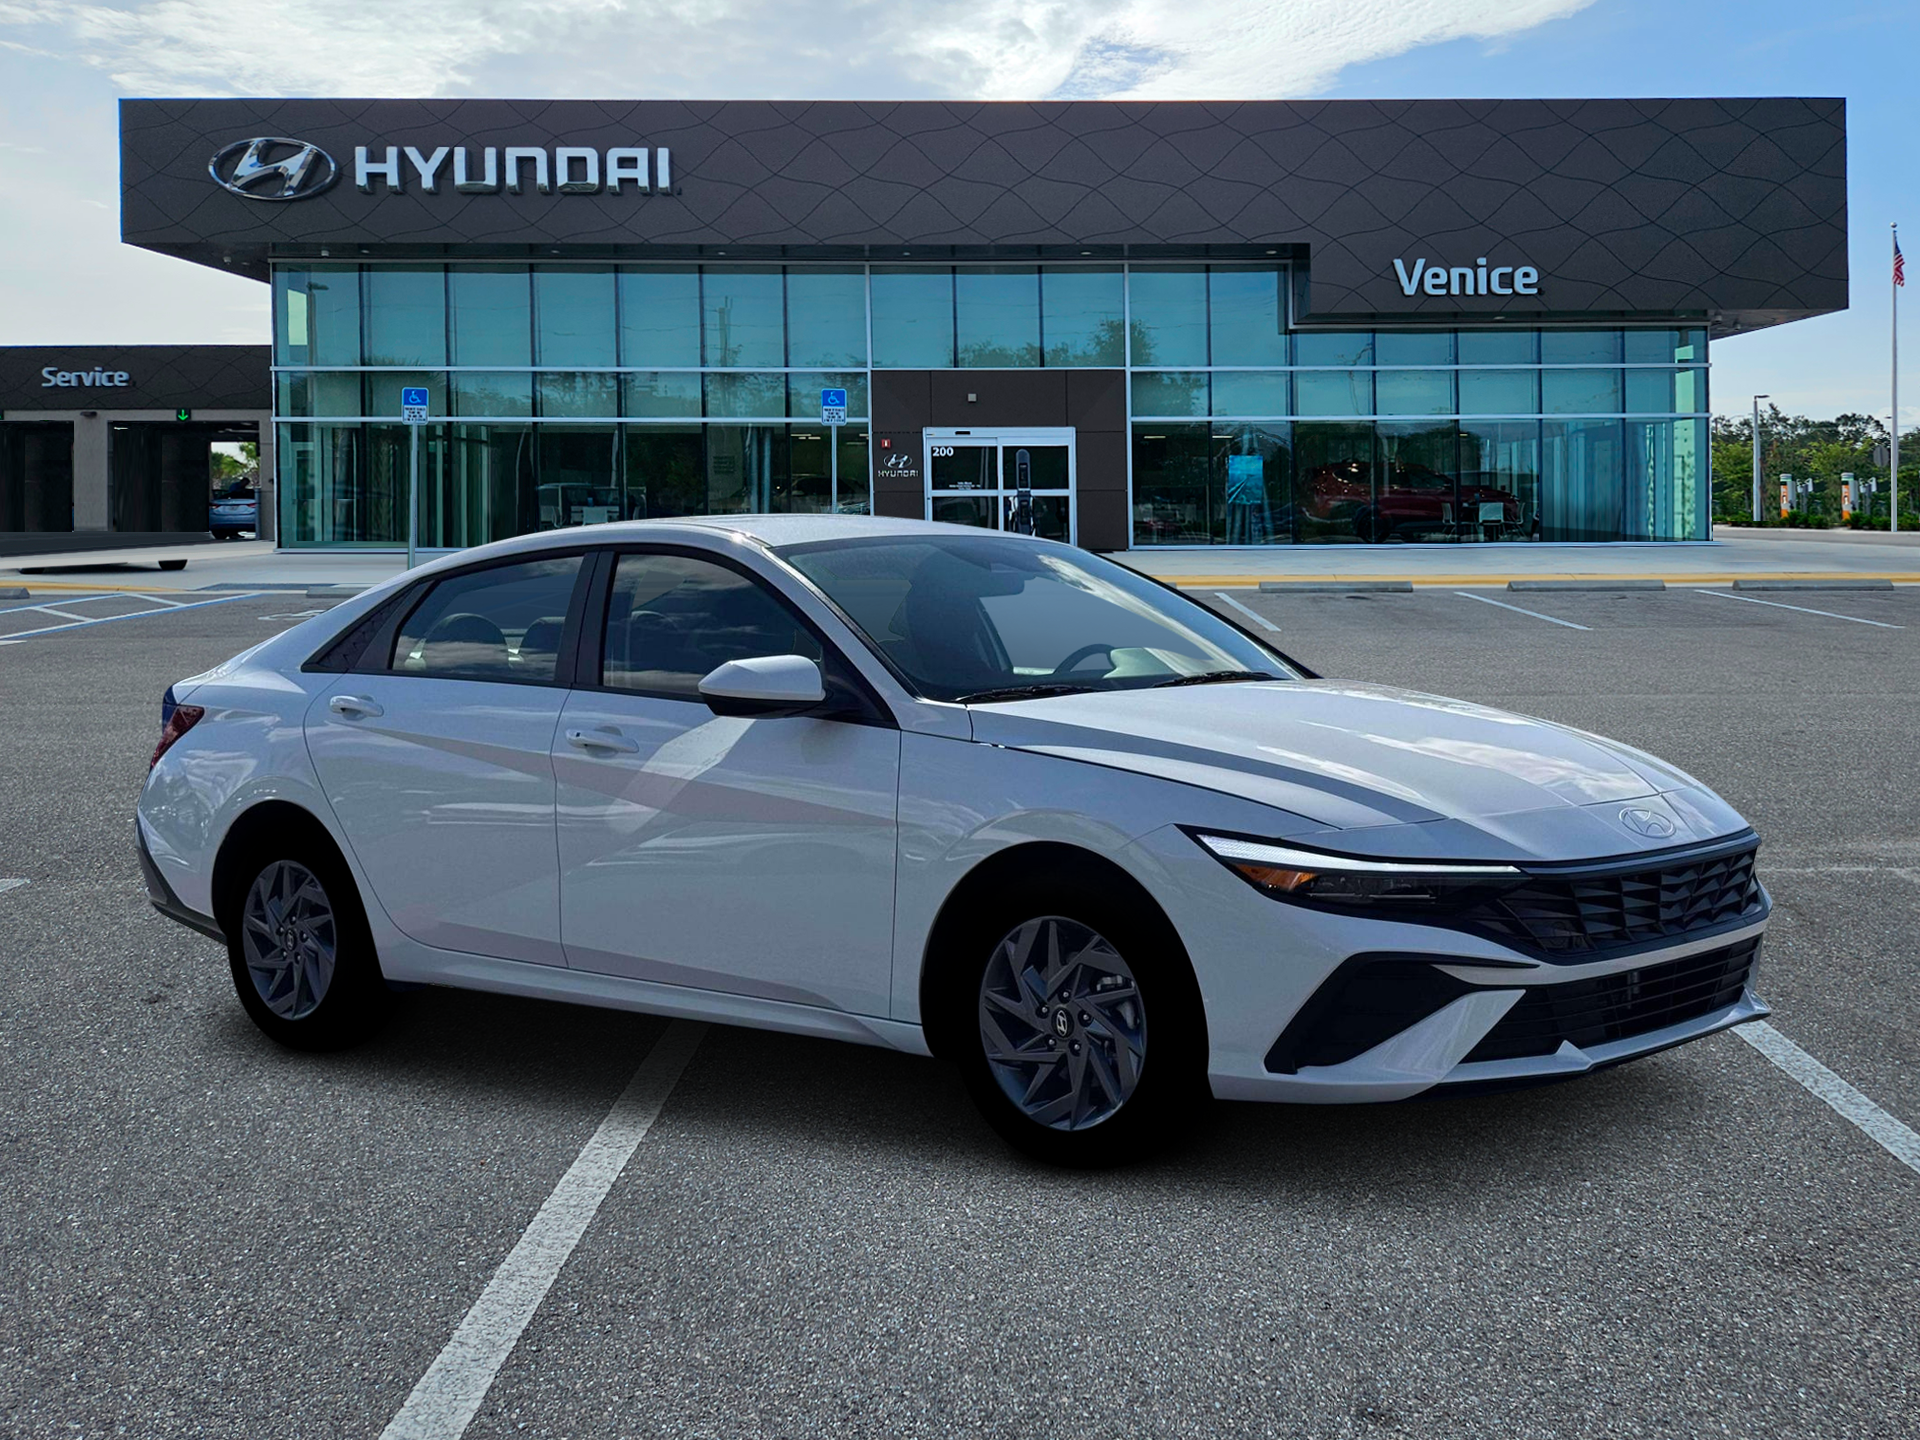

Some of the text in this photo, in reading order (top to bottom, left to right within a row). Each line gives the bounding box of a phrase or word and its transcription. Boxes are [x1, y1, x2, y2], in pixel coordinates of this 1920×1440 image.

[354, 146, 671, 194] HYUNDAI
[1393, 257, 1539, 296] Venice
[41, 367, 129, 387] Service
[932, 447, 954, 457] 200
[877, 469, 919, 478] HYUNDAI
